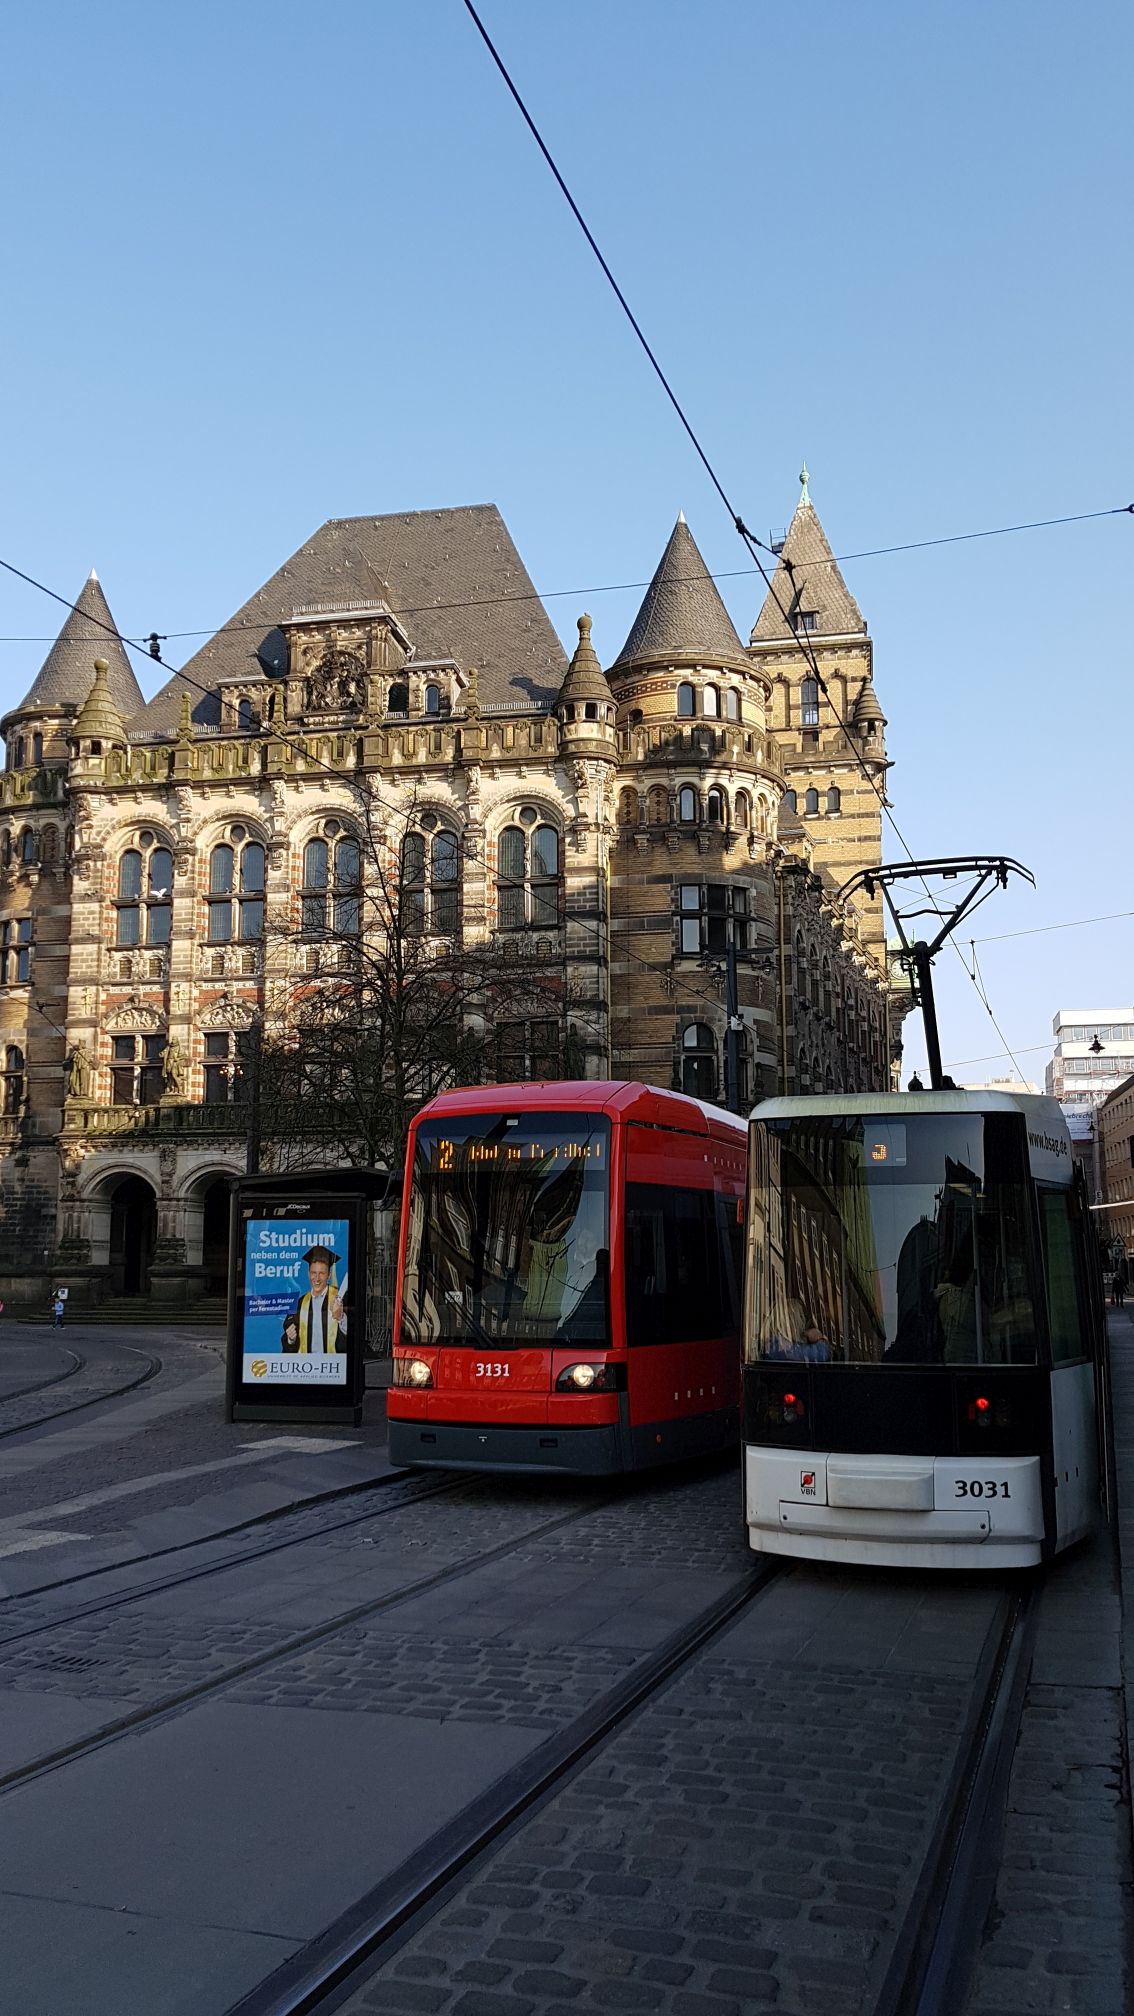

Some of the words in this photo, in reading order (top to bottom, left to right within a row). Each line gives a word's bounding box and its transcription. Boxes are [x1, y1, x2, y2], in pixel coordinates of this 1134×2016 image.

[1028, 1131, 1067, 1157] www.bsag.de
[439, 1139, 453, 1168] 2
[259, 1228, 335, 1247] Studium
[251, 1251, 278, 1259] neben
[280, 1251, 299, 1259] dem
[255, 1262, 302, 1278] Beruf
[270, 1362, 340, 1373] EURO-FH
[476, 1363, 510, 1377] 3131
[955, 1480, 1011, 1498] 3031
